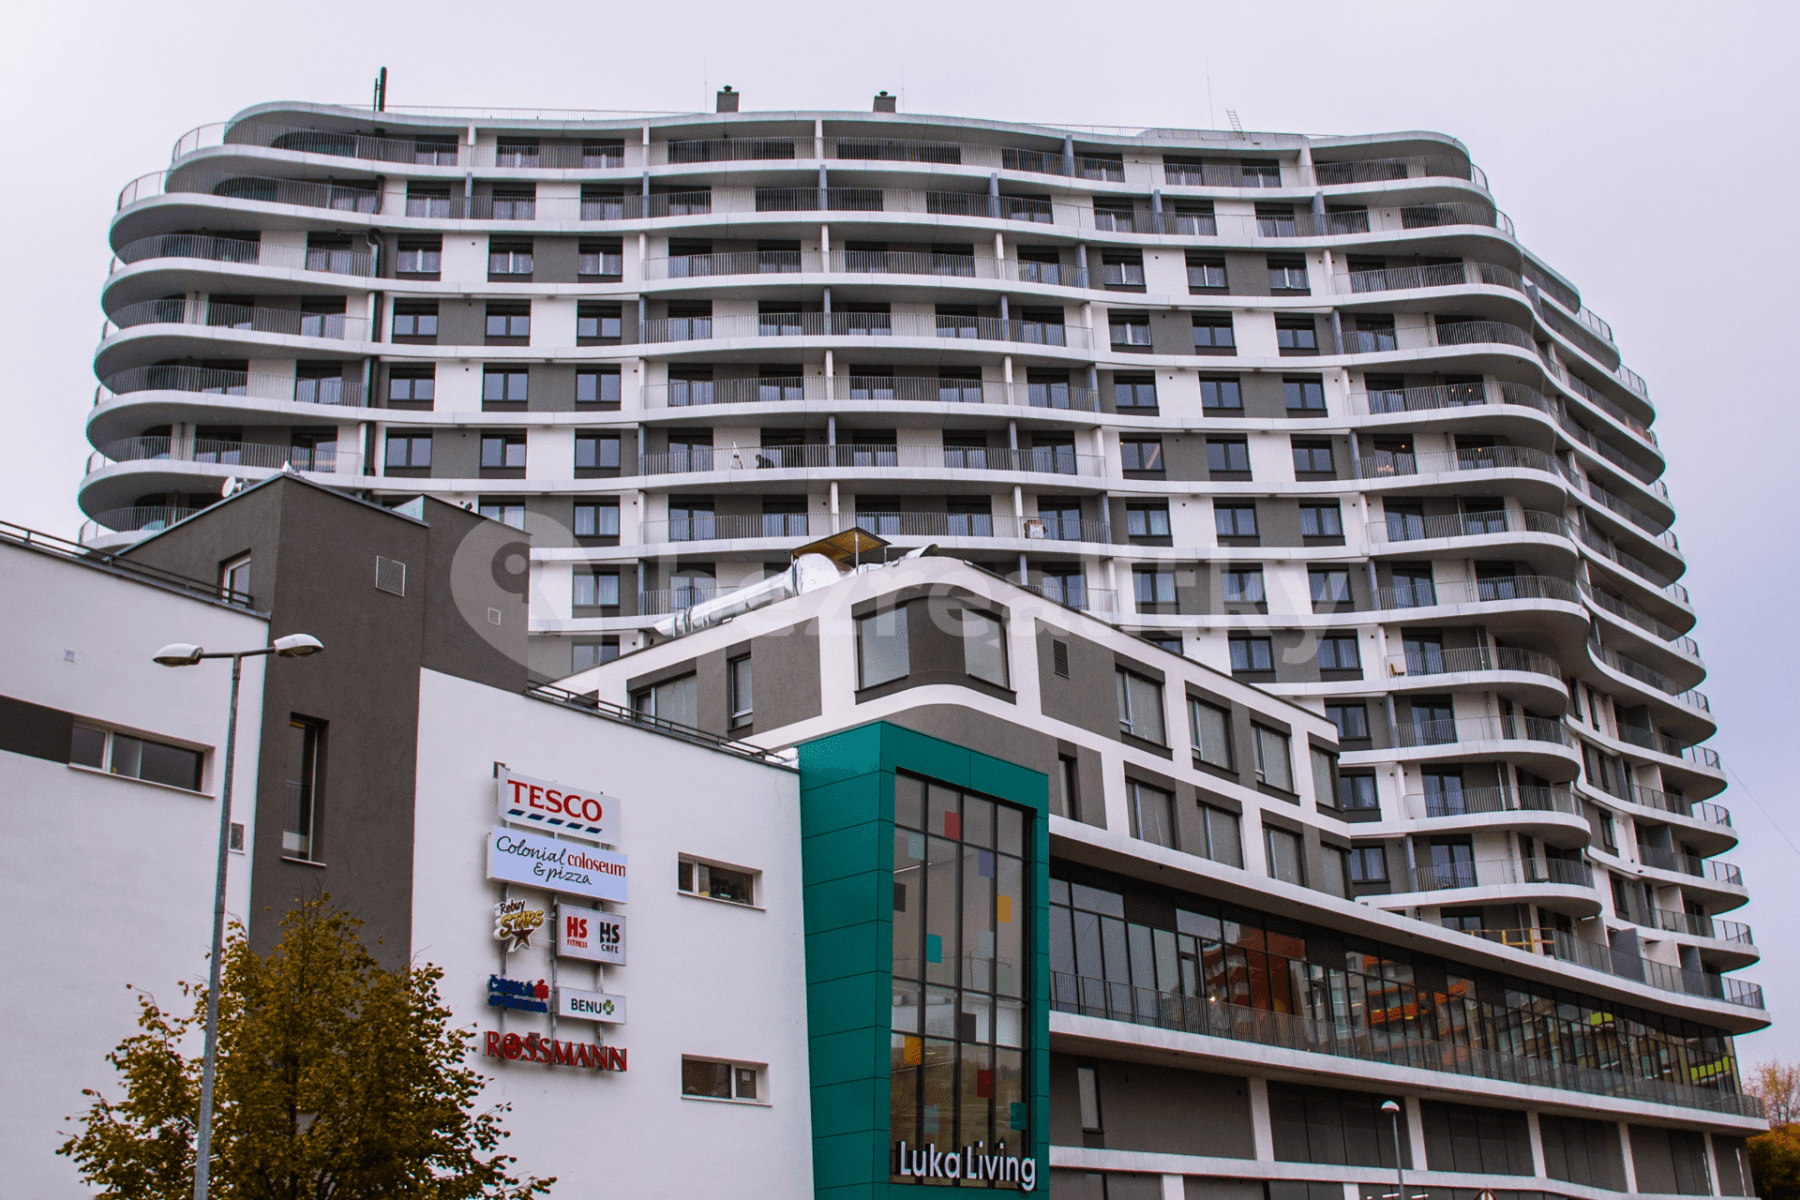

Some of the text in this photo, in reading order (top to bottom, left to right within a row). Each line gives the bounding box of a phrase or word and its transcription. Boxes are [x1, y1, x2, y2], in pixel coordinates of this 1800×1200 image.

[507, 779, 603, 822] TESCO
[496, 836, 626, 878] Colonial coloseum
[533, 862, 592, 885] & pizza
[500, 899, 525, 914] Rebuy
[500, 910, 544, 938] STARS
[567, 916, 587, 938] HS
[600, 921, 620, 944] HS
[567, 939, 588, 948] FITNESS
[571, 998, 602, 1013] BENU
[485, 1031, 627, 1072] ROSSMANN
